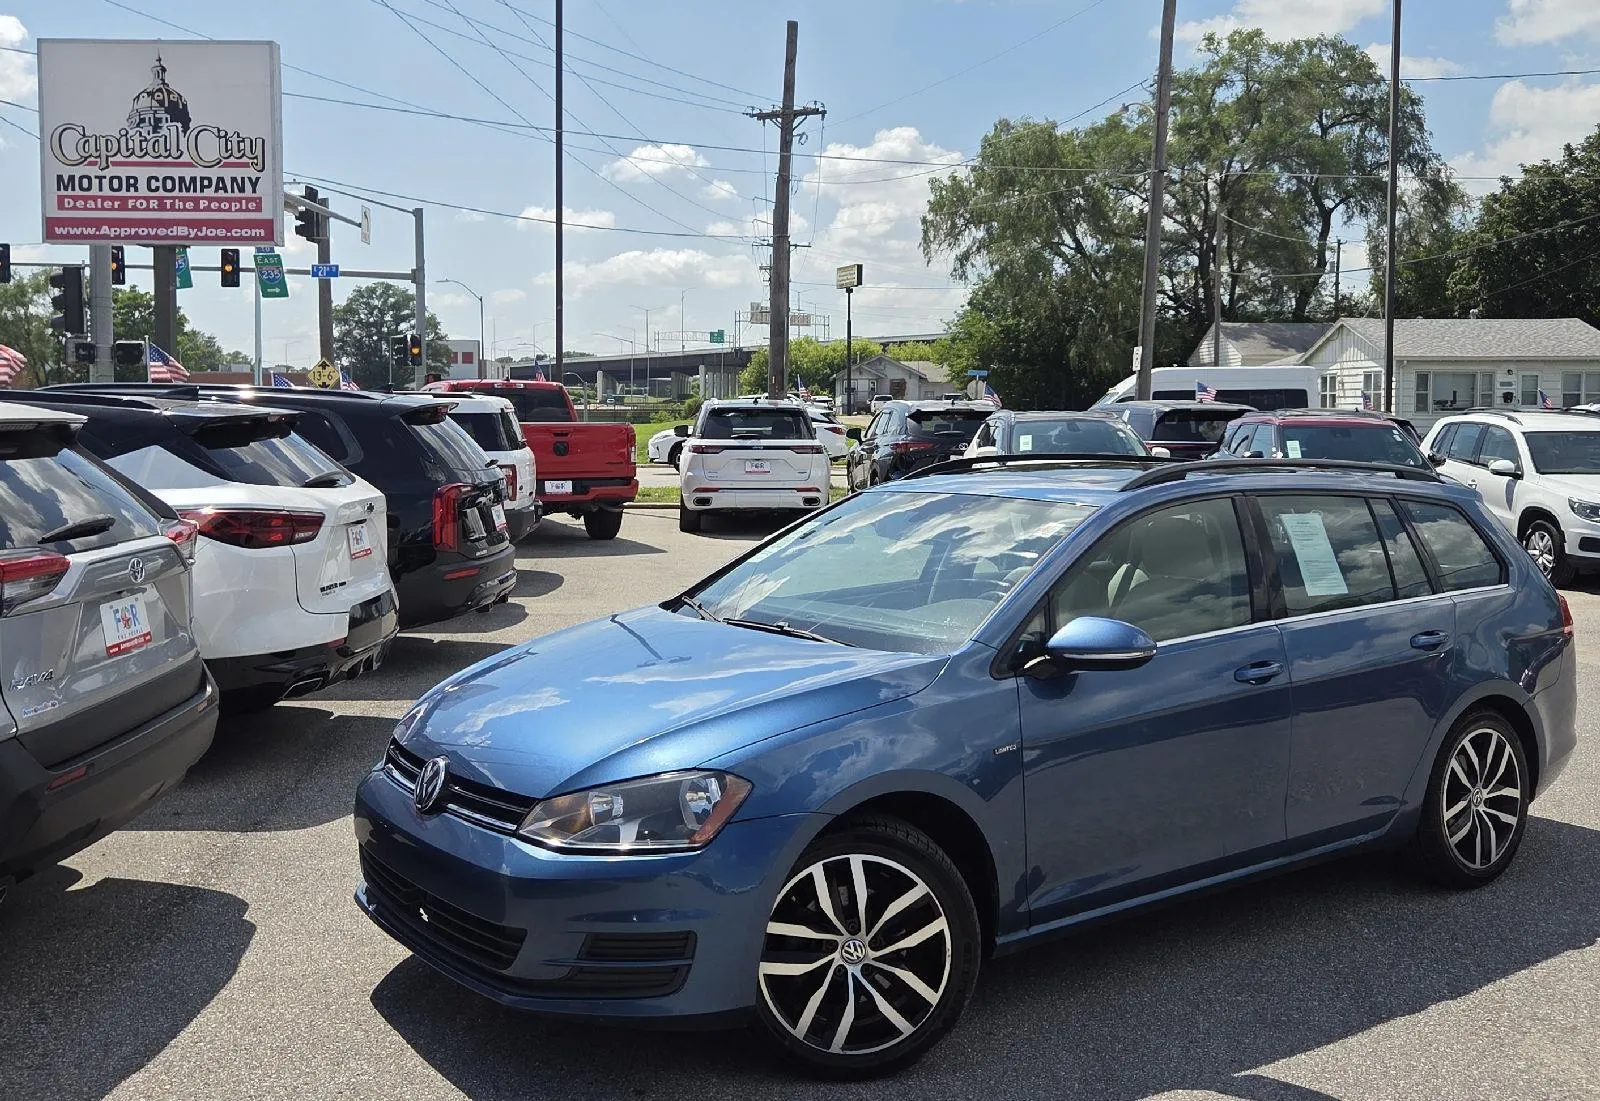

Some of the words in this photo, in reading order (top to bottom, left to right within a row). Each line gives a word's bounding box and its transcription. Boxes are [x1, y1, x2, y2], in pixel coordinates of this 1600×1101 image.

[50, 123, 183, 171] Capital
[187, 125, 265, 172] City
[56, 174, 139, 193] MOTOR
[146, 175, 261, 194] COMPANY
[64, 198, 120, 209] Dealer
[128, 199, 158, 209] FOR
[164, 199, 195, 210] The
[200, 200, 258, 213] People
[54, 225, 265, 239] www.ApprovedByJoe.com
[257, 256, 278, 264] EAST
[261, 270, 281, 280] 235
